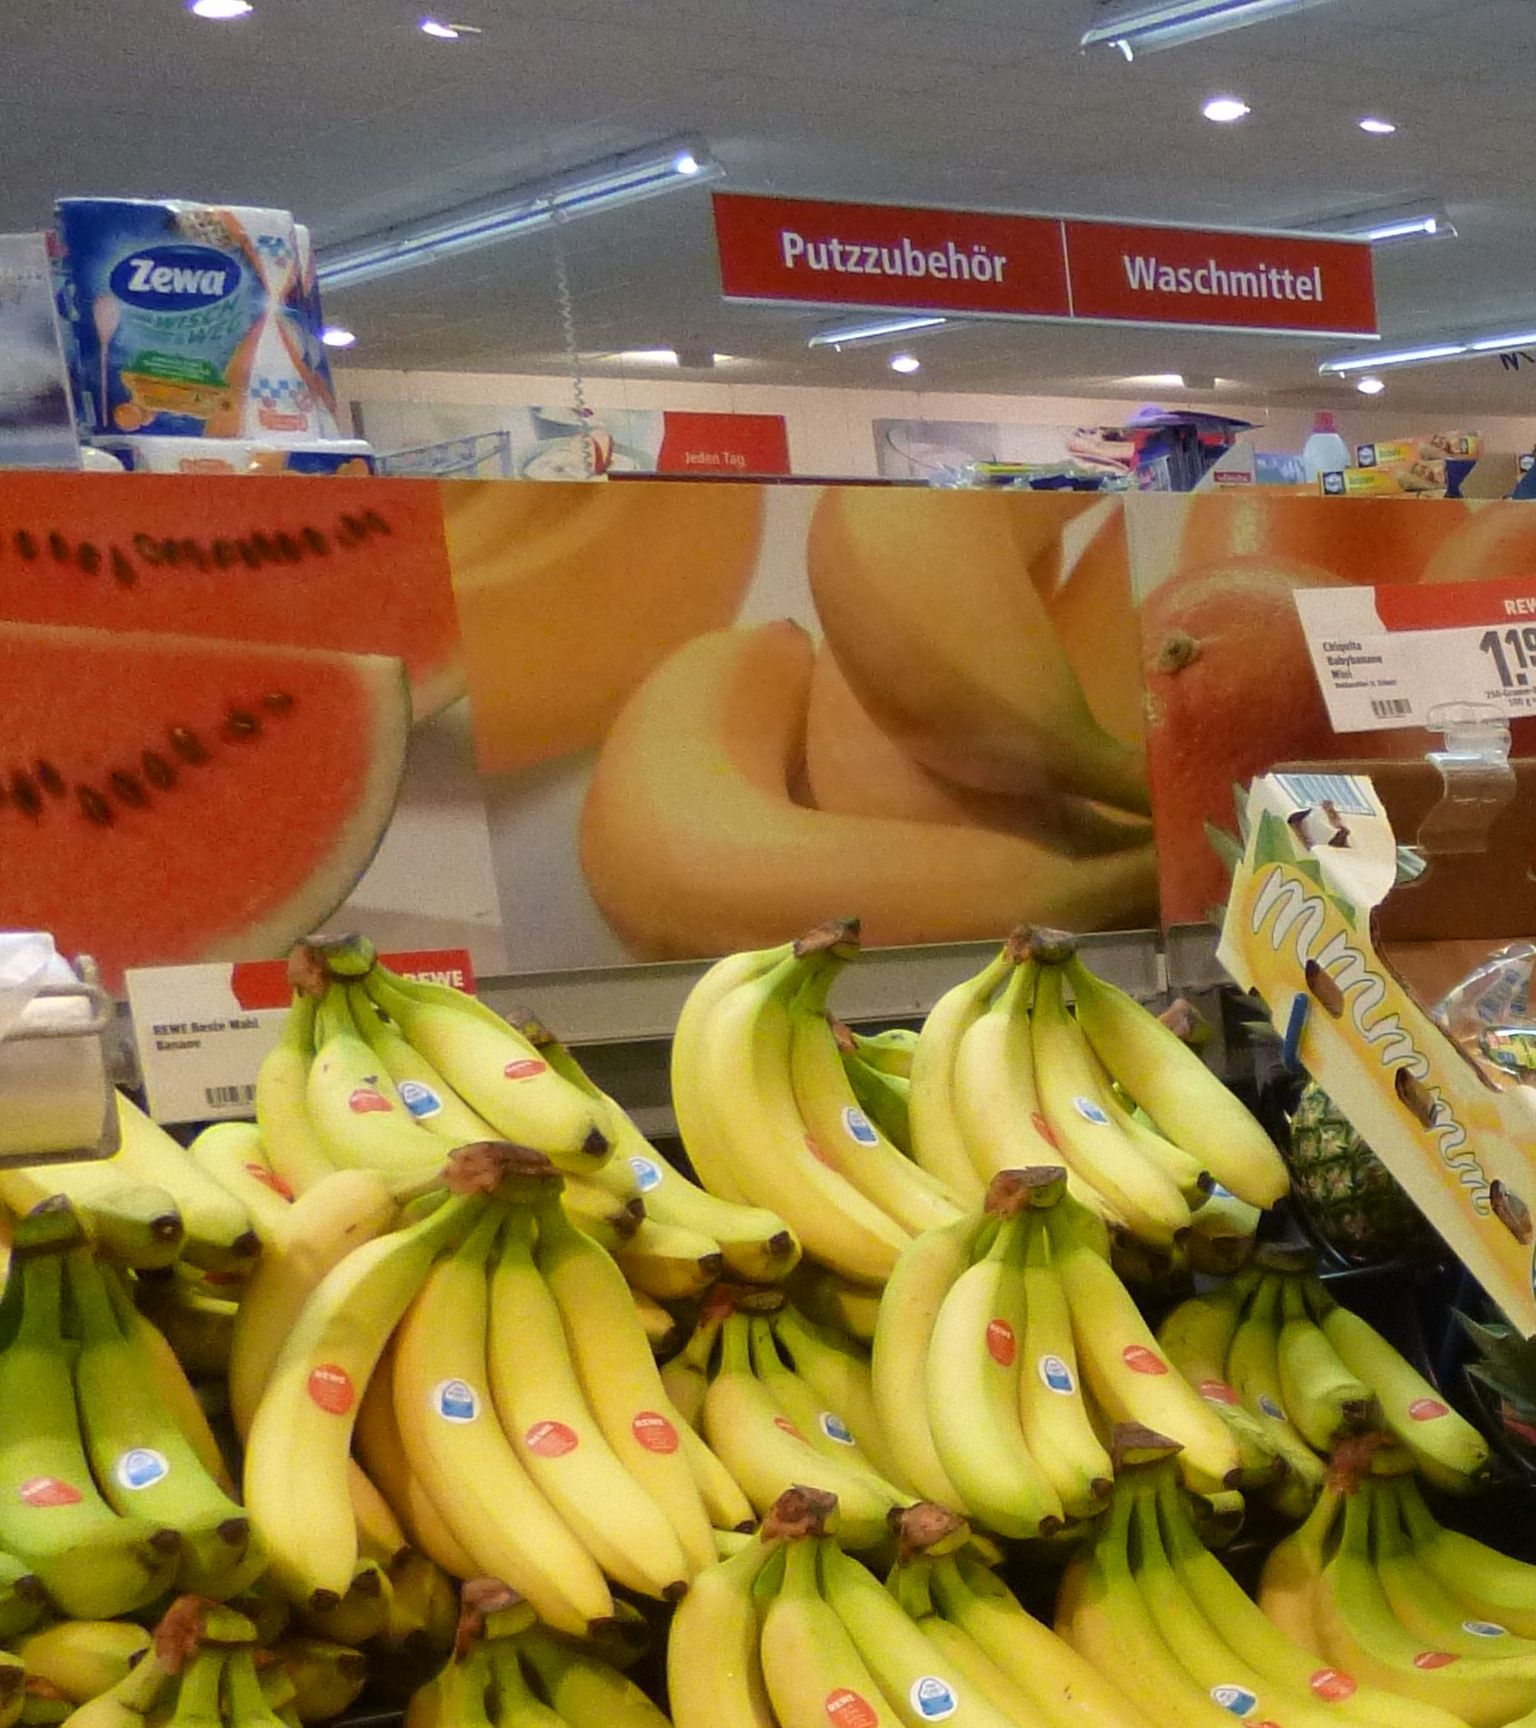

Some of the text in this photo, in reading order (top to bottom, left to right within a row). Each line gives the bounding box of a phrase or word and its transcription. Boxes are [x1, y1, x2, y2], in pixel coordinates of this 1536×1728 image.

[783, 231, 1006, 282] Putzzubehör
[128, 258, 227, 296] Zewa
[1124, 255, 1323, 302] Waschmittel
[1322, 640, 1363, 655] Chiquita
[152, 1022, 188, 1036] REWE
[155, 1038, 202, 1052] Banane
